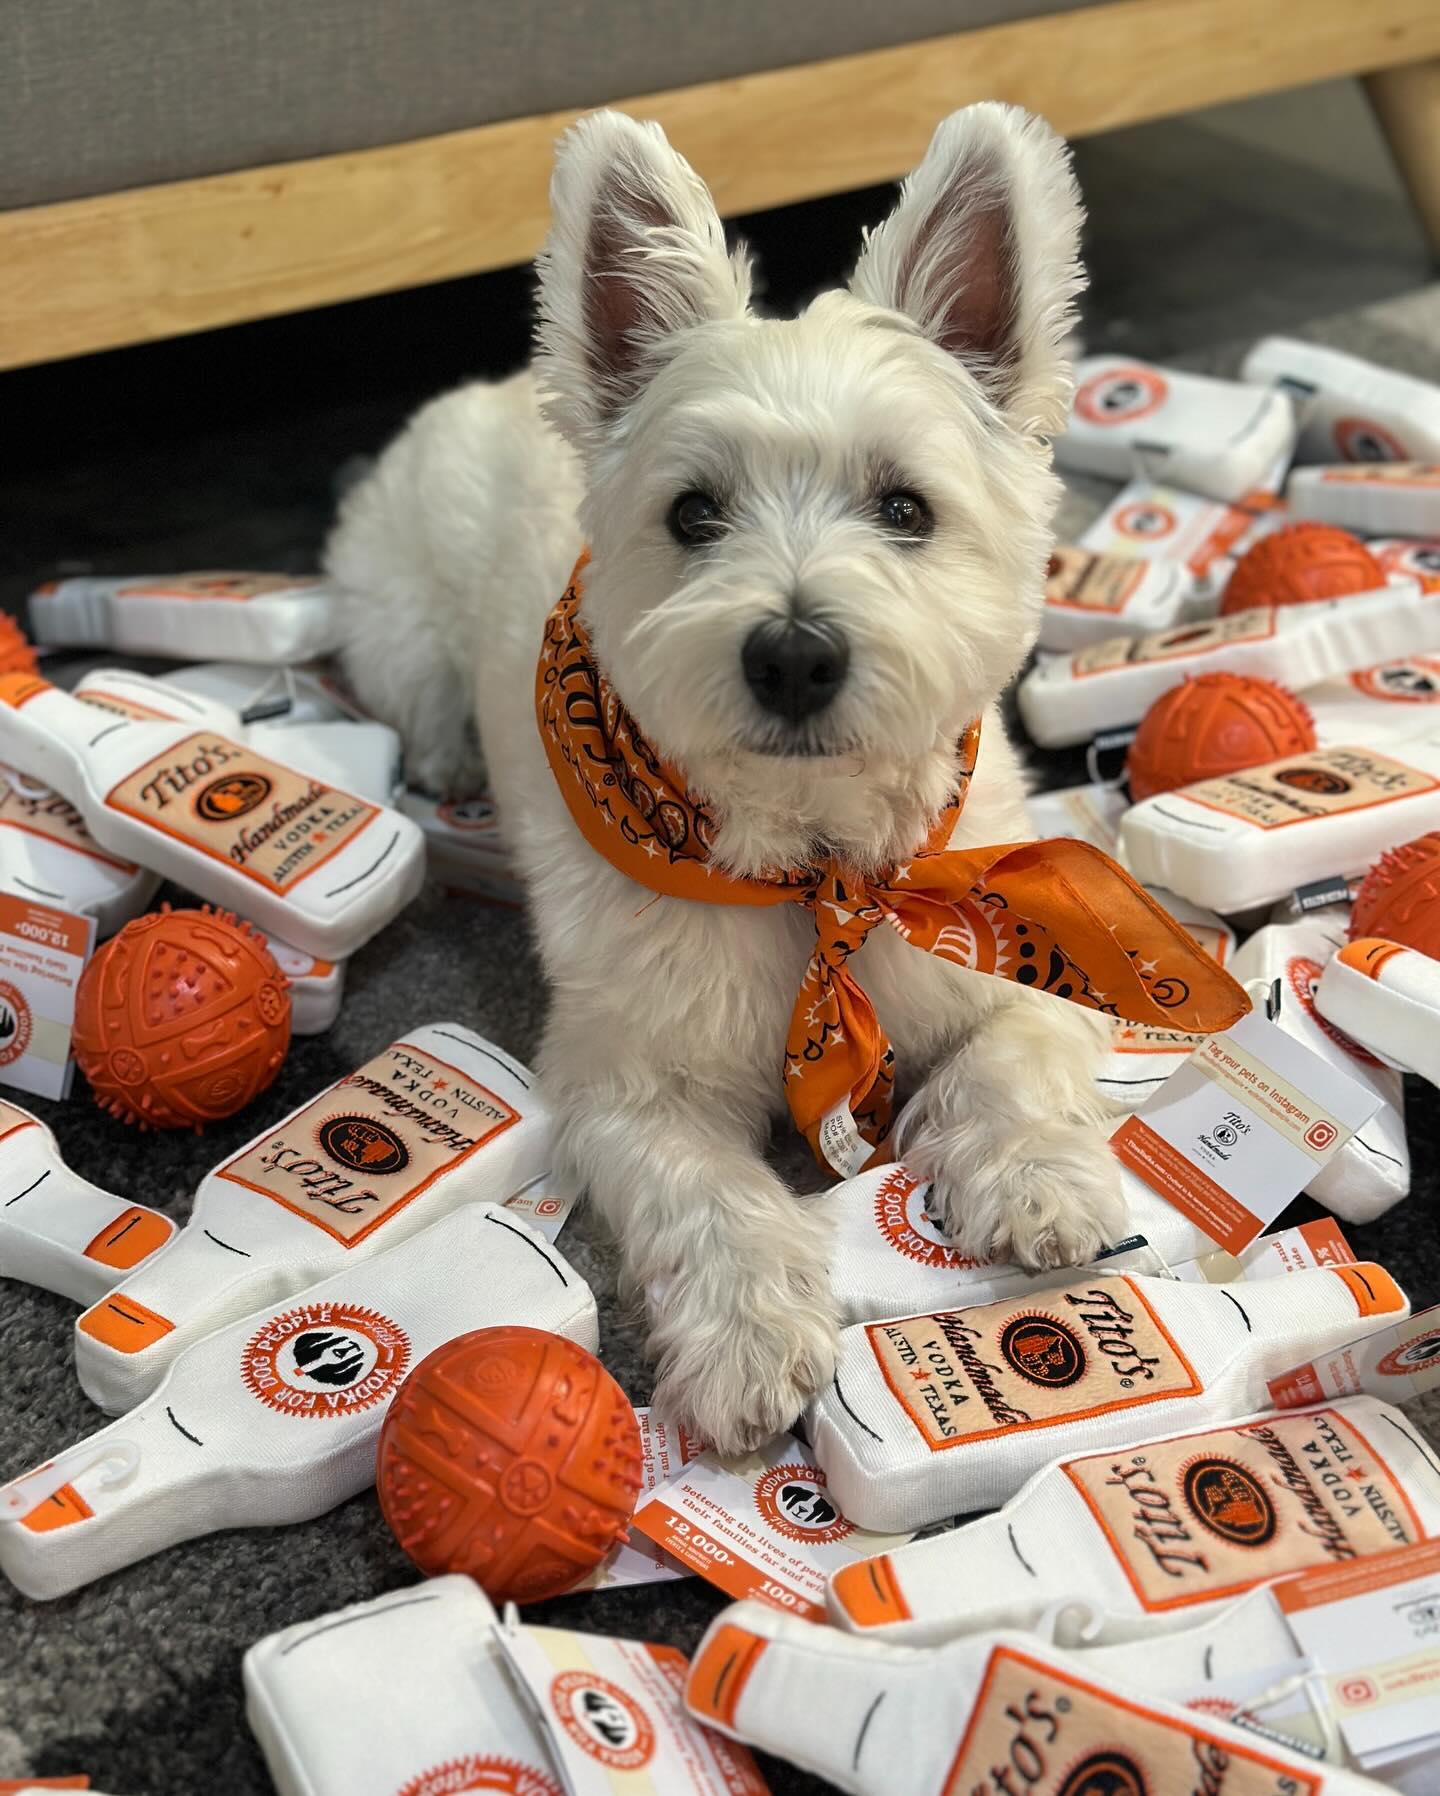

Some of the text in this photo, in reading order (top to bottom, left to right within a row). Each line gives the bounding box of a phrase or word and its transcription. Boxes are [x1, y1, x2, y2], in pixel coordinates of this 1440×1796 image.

[274, 806, 334, 850] VODKA
[391, 1069, 459, 1119] VODKA
[449, 1087, 505, 1120] AUSTIN
[1208, 1041, 1223, 1058] Tag
[1220, 1055, 1241, 1070] your
[1238, 1068, 1258, 1084] pets
[1257, 1081, 1270, 1092] on
[1269, 1089, 1310, 1124] Instagram
[1197, 1134, 1232, 1161] Handmade
[1223, 1111, 1251, 1135] Tito's
[261, 1146, 379, 1214] Tito's
[884, 1192, 935, 1258] FOR DOG
[256, 1310, 332, 1351] PEOPLE
[1064, 1290, 1160, 1380] Tito's
[252, 1356, 278, 1389] DOG
[326, 1368, 394, 1408] VODKA
[883, 1327, 957, 1437] AUSTIN TEXAS
[922, 1340, 969, 1405] VODKA
[932, 1314, 1031, 1424] Handmade
[275, 1387, 316, 1409] FOR
[639, 1413, 650, 1434] and
[643, 1437, 655, 1460] pets
[655, 1422, 666, 1448] wide
[644, 1463, 654, 1474] of
[658, 1451, 670, 1471] and
[761, 1470, 792, 1497] VODKA
[1302, 1440, 1361, 1517] VODKA
[1235, 1426, 1358, 1561] Handmade
[1359, 1484, 1410, 1544] AUSTIN
[664, 1516, 736, 1567] 12,000+
[681, 1484, 737, 1526] Bettering
[737, 1521, 757, 1538] the
[760, 1537, 787, 1560] lives
[788, 1556, 803, 1568] of
[682, 1497, 712, 1521] their
[712, 1518, 759, 1555] families
[761, 1552, 779, 1568] far
[779, 1565, 803, 1584] and
[1105, 1463, 1210, 1578] Tito's
